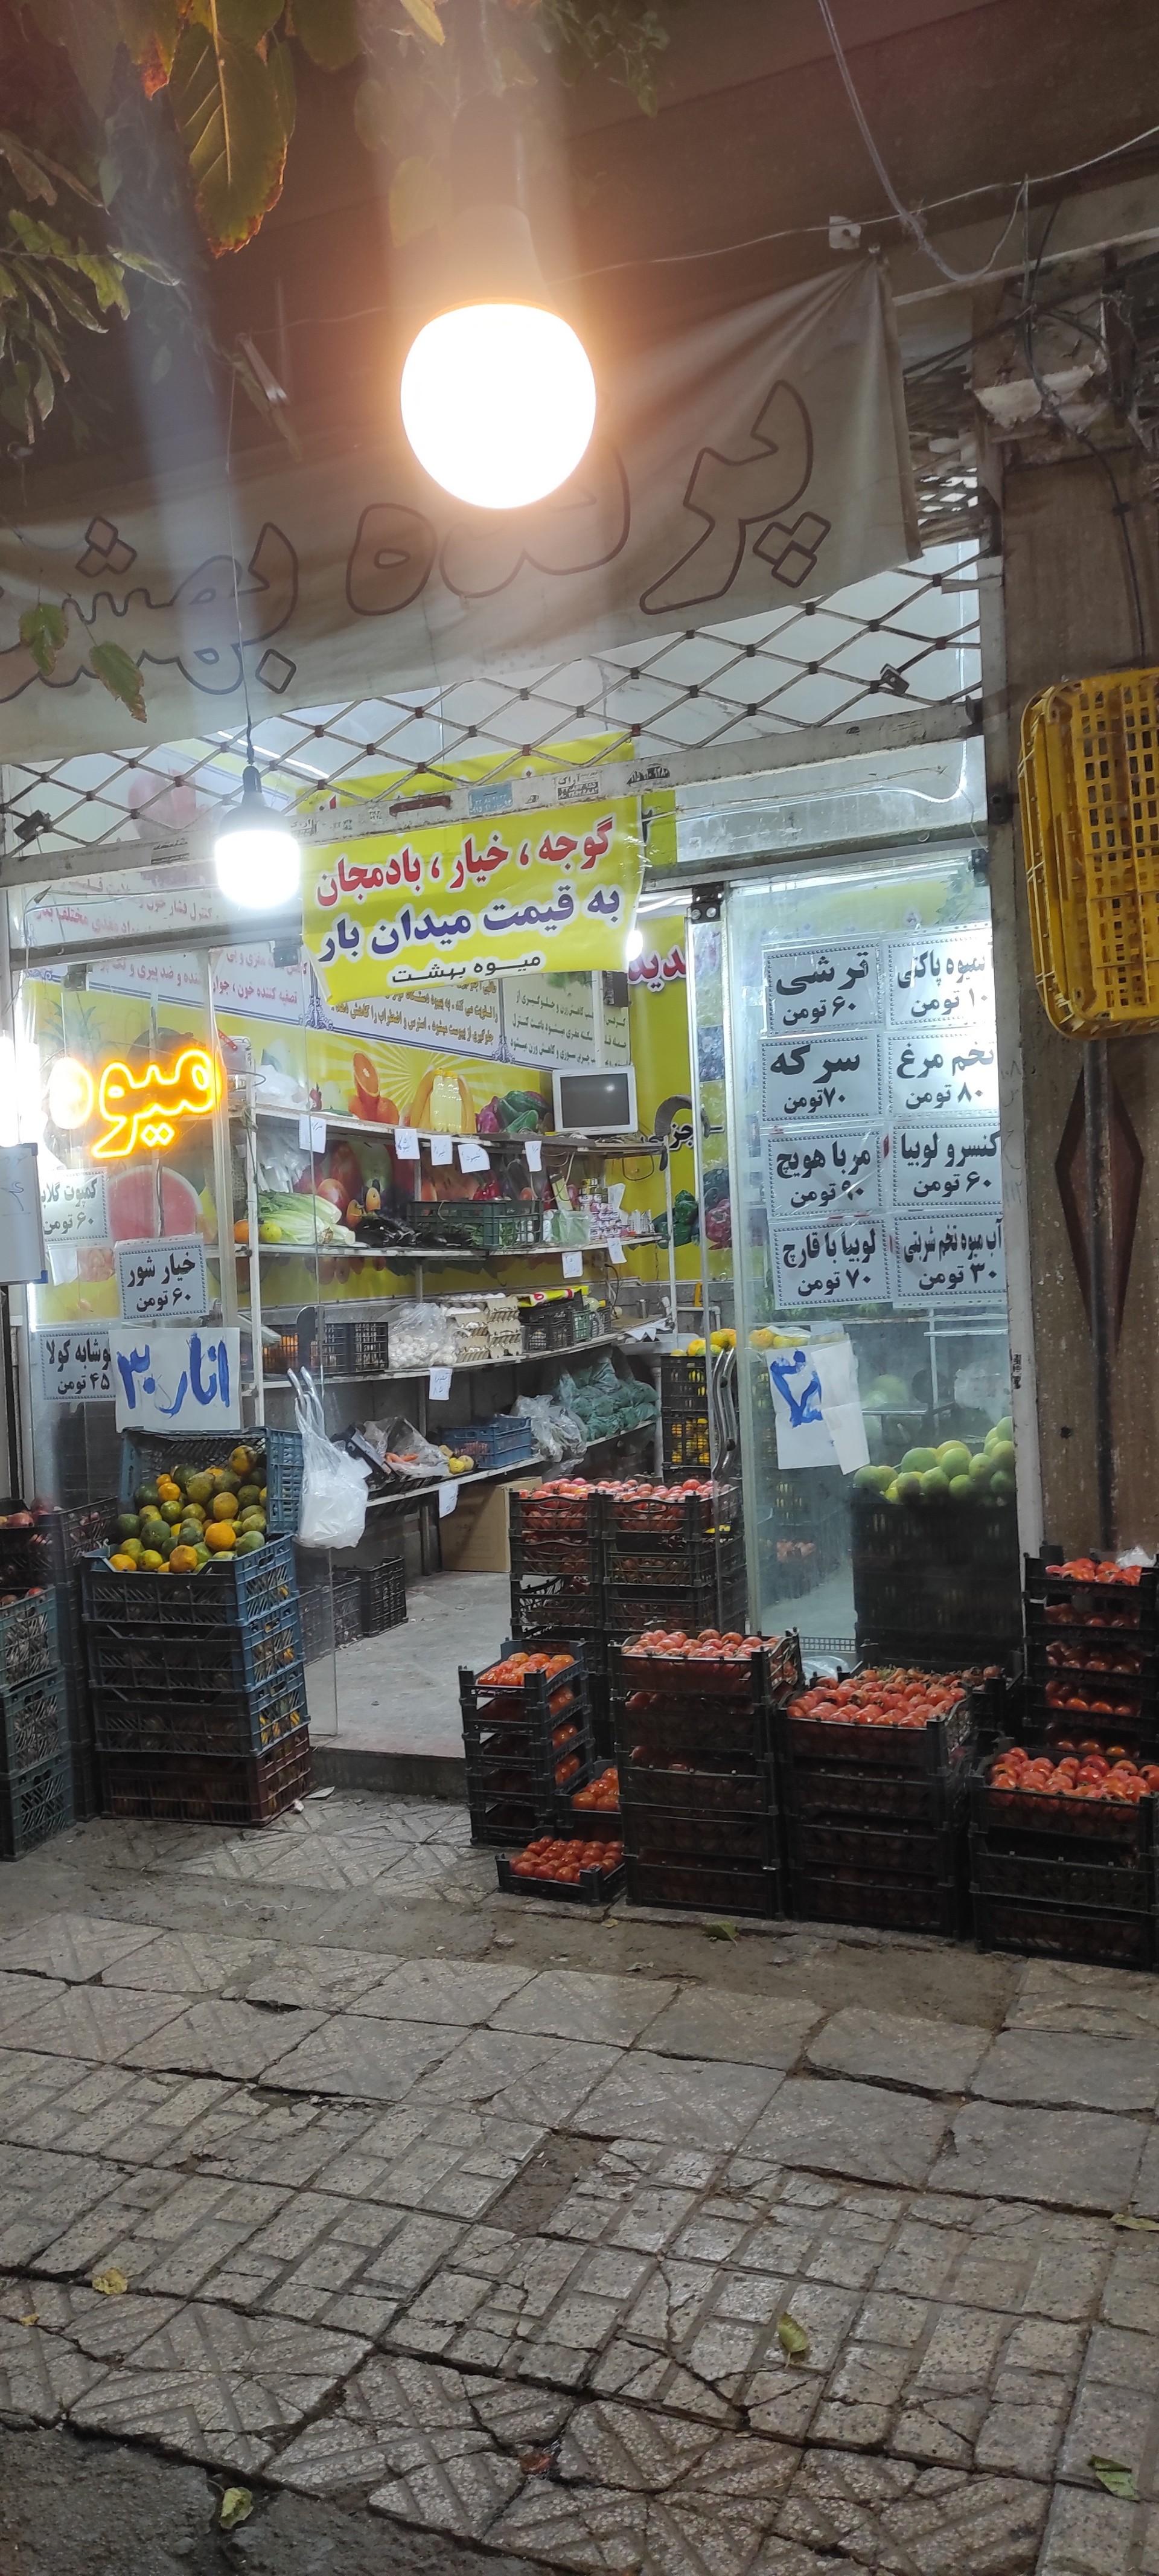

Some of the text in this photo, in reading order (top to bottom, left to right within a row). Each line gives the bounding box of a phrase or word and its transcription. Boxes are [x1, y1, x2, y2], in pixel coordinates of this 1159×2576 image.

[450, 834, 509, 888] خیار
[538, 818, 613, 870] گوجه
[317, 847, 421, 906] بادمجان
[318, 884, 620, 961] به قیمت میدان بار
[392, 955, 541, 984] میوه بهشت
[776, 951, 869, 995] ترشی
[783, 996, 857, 1026] ۶۰ تومن
[912, 988, 988, 1017] ۱۰ تومن
[770, 1043, 860, 1084] سرکه
[897, 1040, 995, 1078] تخم مرغ
[48, 1048, 222, 1159] میوه
[906, 1081, 983, 1109] ۸۰ تومن
[832, 1140, 870, 1175] مربا
[901, 1130, 1001, 1168] کنسرو لوبیا
[63, 1177, 97, 1207] کمپوت
[791, 1180, 864, 1208] ۹۰ تومن
[913, 1171, 992, 1197] ۶۰ تومن
[43, 1211, 94, 1235] ۶۰ تومن
[986, 1217, 1004, 1258] آب
[783, 1227, 875, 1268] لوبیا با قارچ
[961, 1232, 983, 1260] میوه
[127, 1251, 196, 1287] خیار شور
[798, 1268, 871, 1296] ۷۰ تومن
[919, 1262, 997, 1290] ۳۰ تومن
[136, 1287, 191, 1312] ۶۰ تومن
[46, 1338, 112, 1372] وشابه کولا
[57, 1372, 110, 1394] ۴۵ تومن
[156, 1331, 230, 1418] انار
